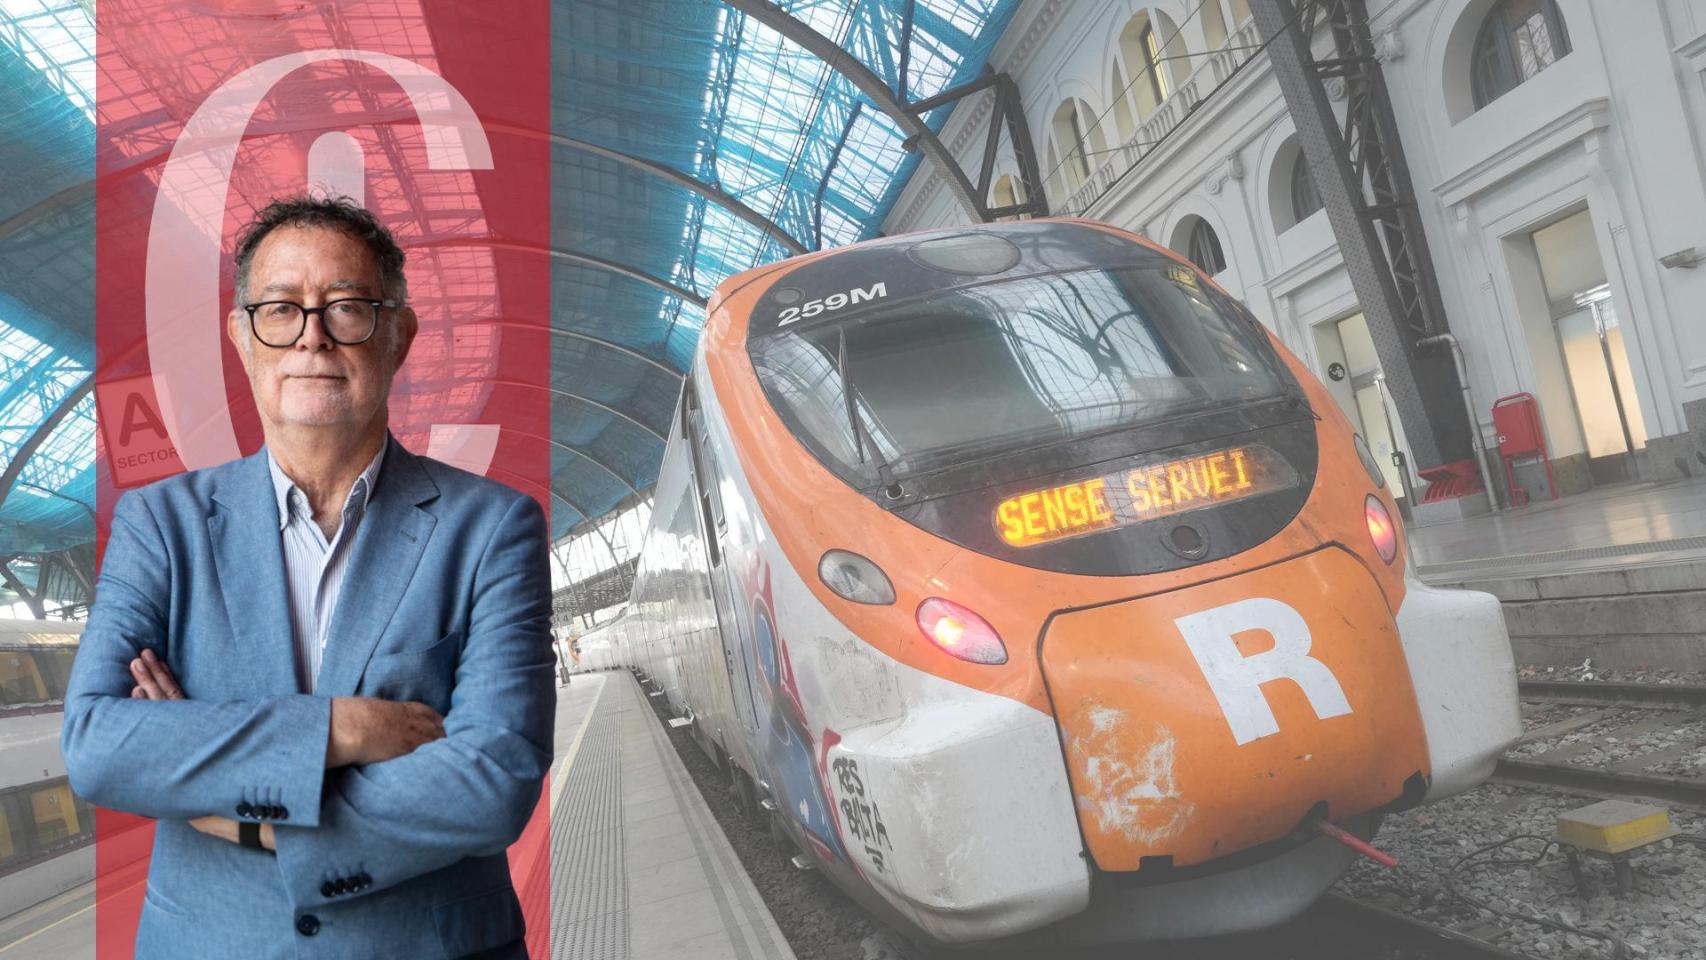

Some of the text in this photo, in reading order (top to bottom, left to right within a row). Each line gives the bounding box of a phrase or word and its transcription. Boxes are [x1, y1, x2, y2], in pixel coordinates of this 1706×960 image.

[778, 282, 887, 327] 259M
[119, 392, 169, 447] A
[997, 448, 1252, 542] SENSE SERVEI
[1173, 597, 1353, 746] R
